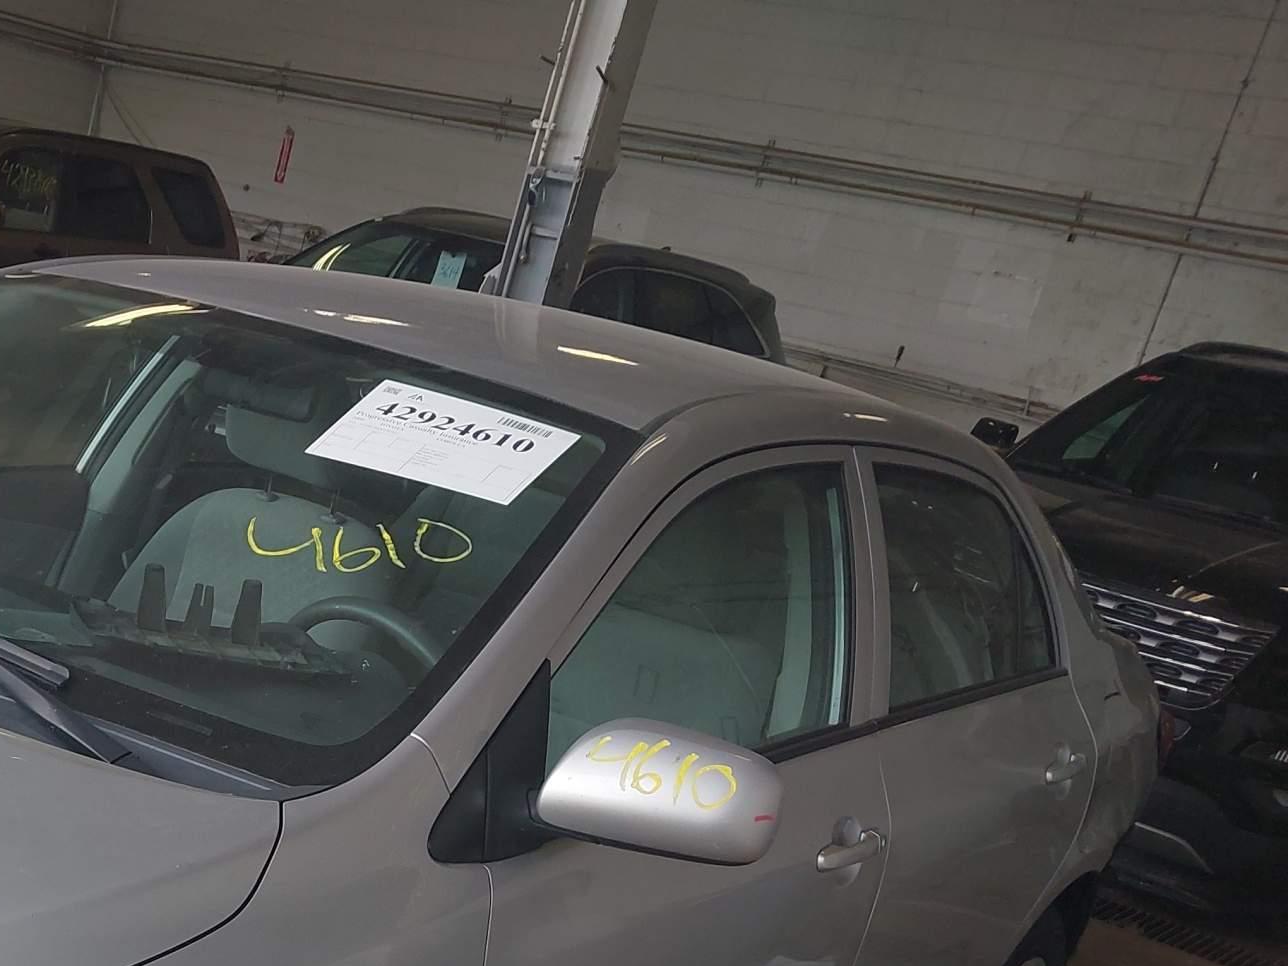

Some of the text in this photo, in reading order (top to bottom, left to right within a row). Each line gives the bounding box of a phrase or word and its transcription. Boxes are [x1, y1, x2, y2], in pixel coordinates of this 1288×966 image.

[375, 402, 535, 453] 42924610
[247, 515, 473, 573] 4610
[585, 735, 737, 810] 4610
